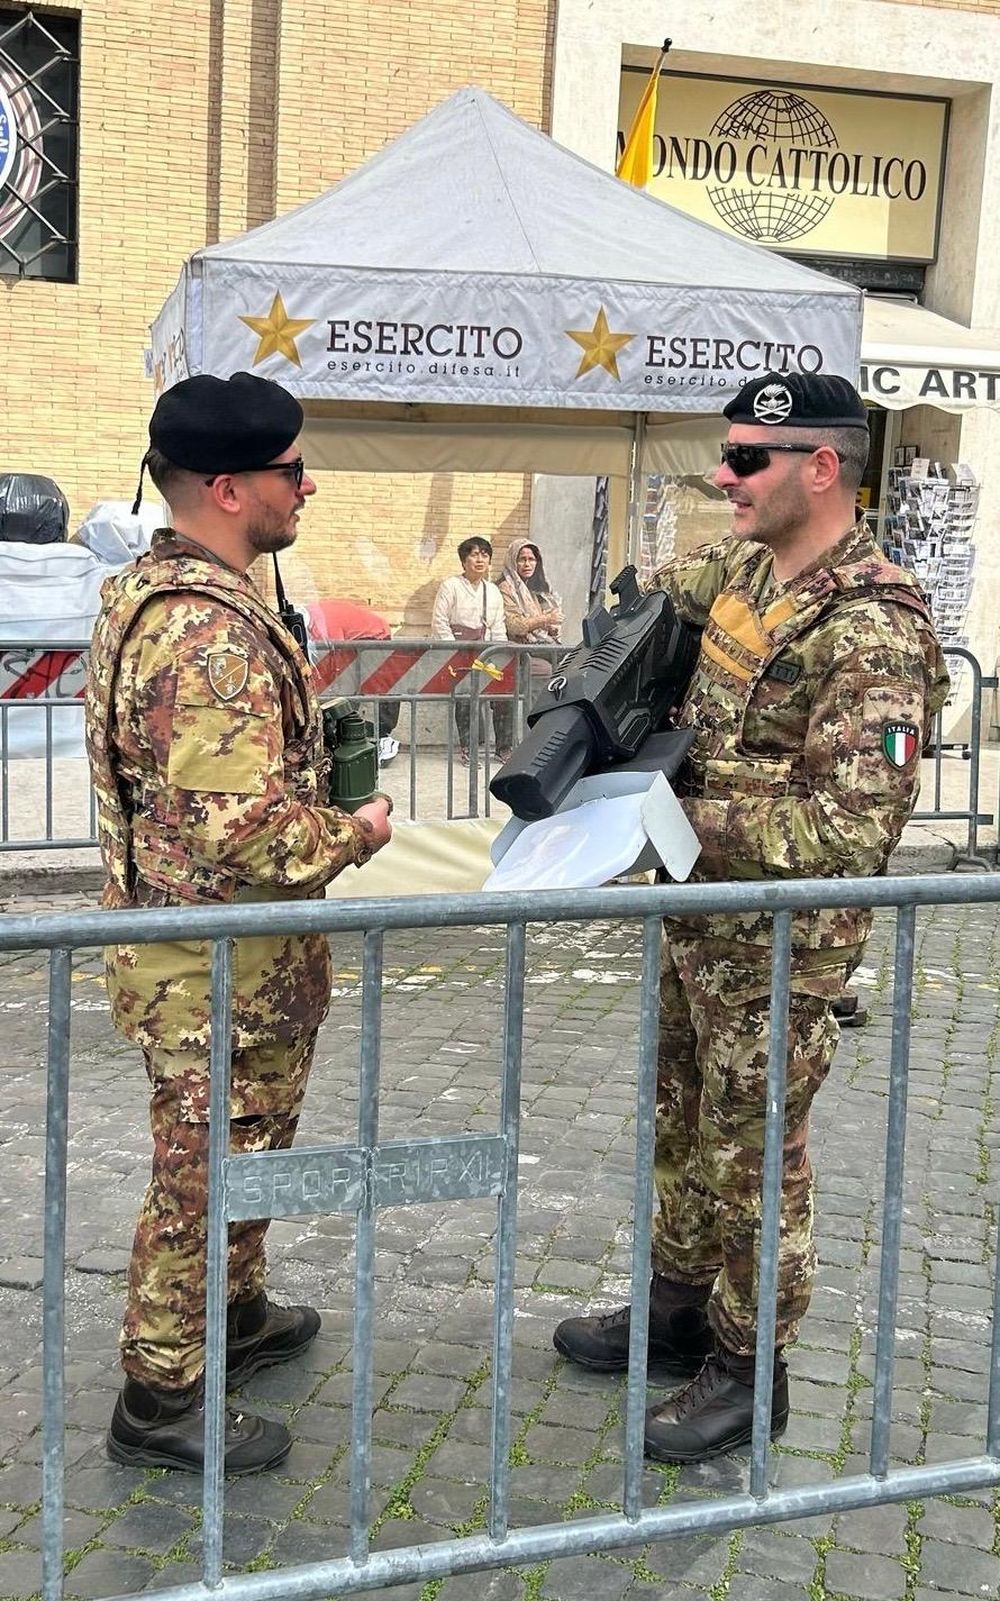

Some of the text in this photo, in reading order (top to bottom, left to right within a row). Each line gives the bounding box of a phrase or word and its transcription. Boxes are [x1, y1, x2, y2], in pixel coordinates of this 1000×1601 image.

[745, 144, 926, 201] CATTOLICO
[326, 320, 522, 359] ESERCITO
[645, 335, 823, 374] ESERCITO
[327, 361, 520, 377] esercito.difesa.it
[644, 374, 752, 387] esercito.d
[887, 726, 915, 735] ITALIA
